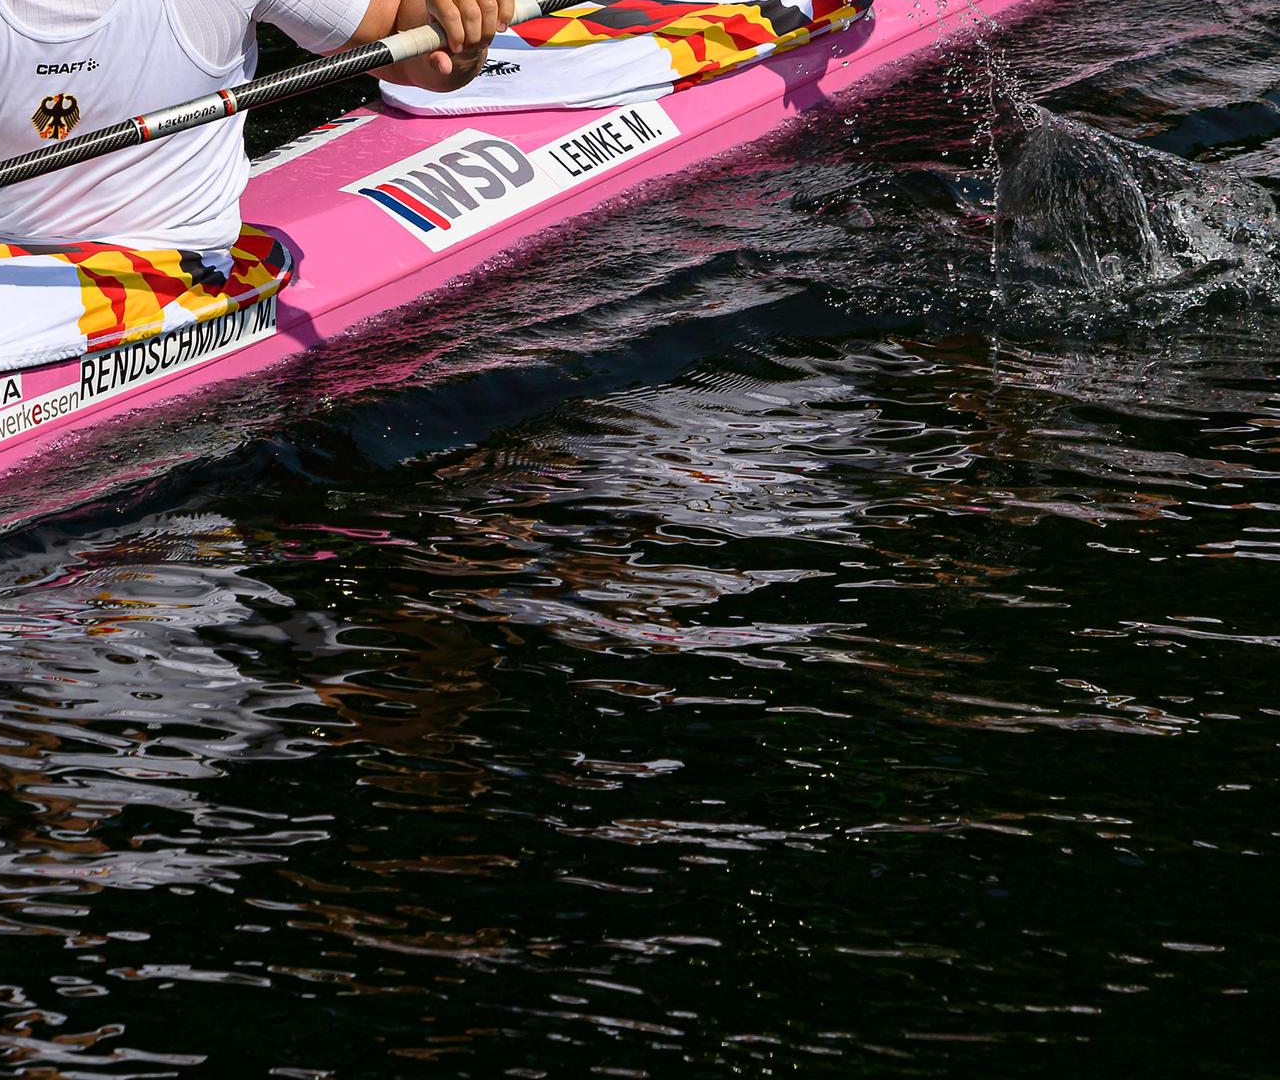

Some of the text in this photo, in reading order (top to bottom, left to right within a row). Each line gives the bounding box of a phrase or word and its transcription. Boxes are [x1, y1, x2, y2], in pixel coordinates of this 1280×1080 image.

[36, 60, 87, 75] CRAFT
[549, 109, 663, 177] LEMKE M.
[80, 295, 277, 401] RENDSCHMIDT M.
